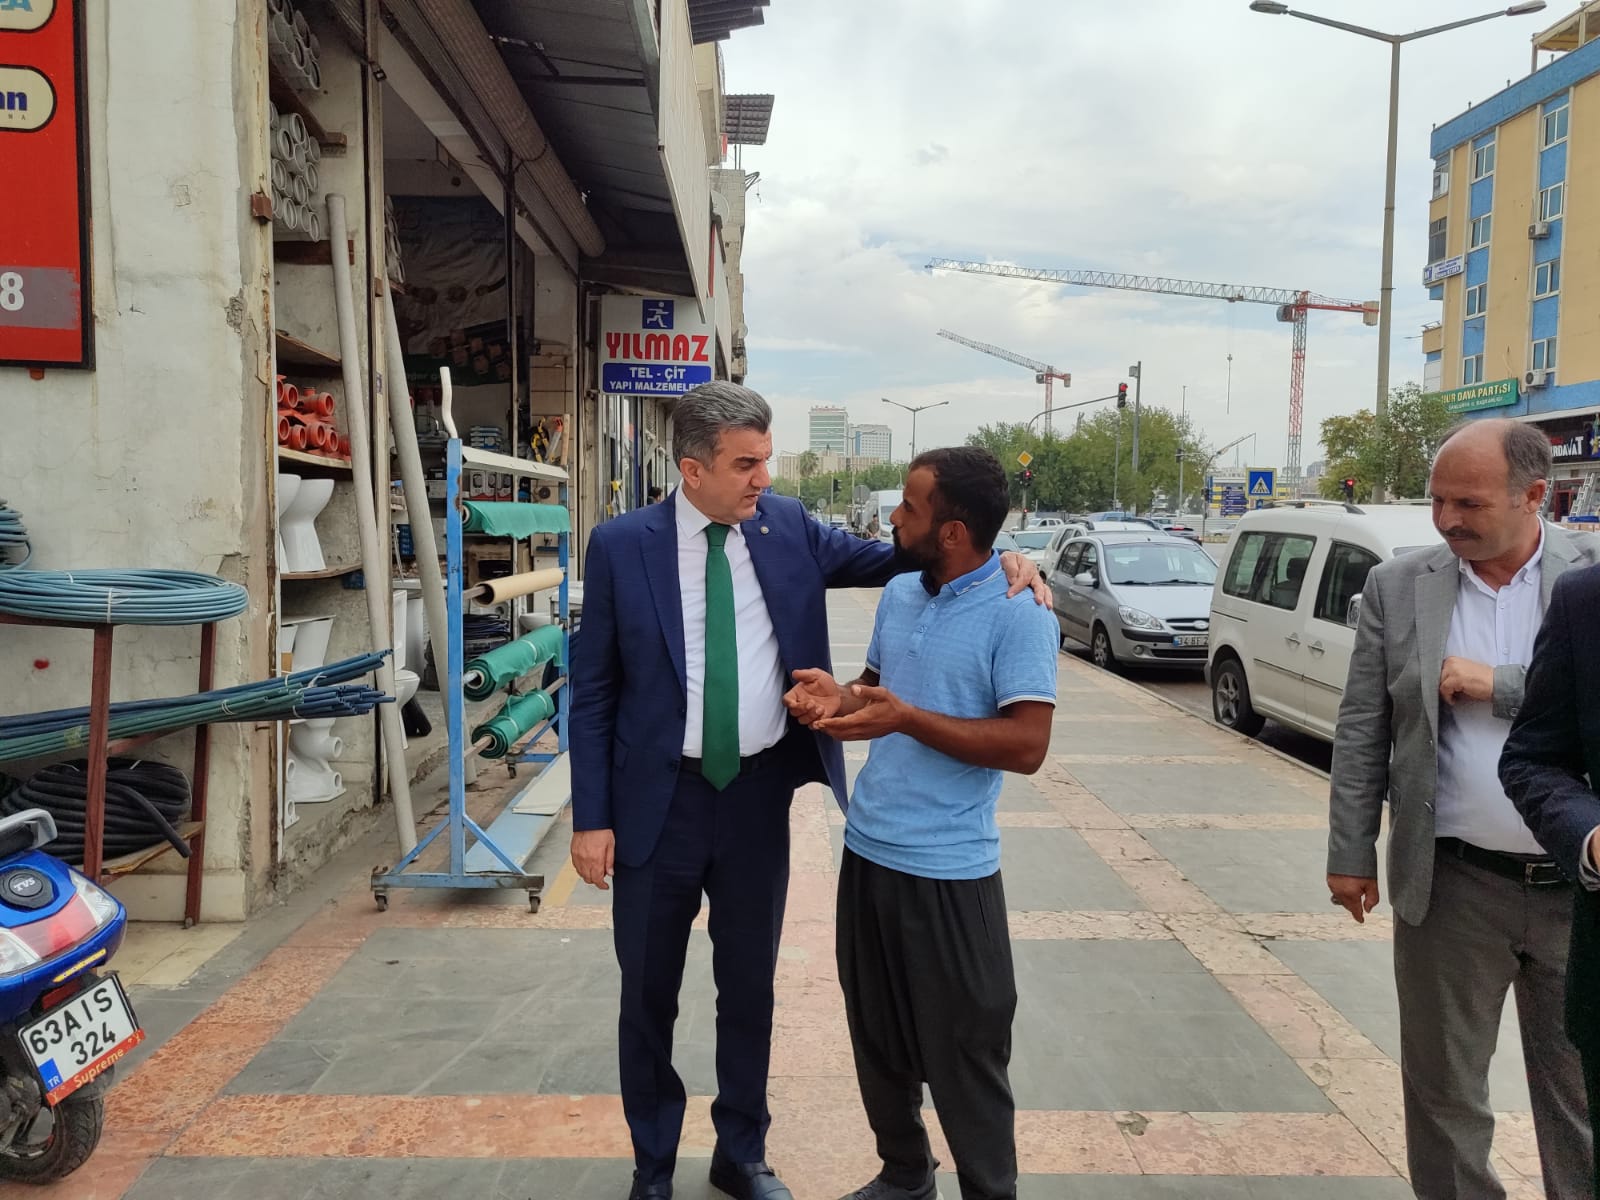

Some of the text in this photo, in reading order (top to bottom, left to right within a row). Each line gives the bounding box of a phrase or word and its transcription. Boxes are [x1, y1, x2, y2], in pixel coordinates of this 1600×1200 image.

[0, 271, 25, 311] 8
[606, 332, 709, 361] YILMAZ
[629, 367, 653, 378] TEL
[664, 366, 686, 381] ÇİT
[609, 381, 705, 392] YAPI MALZEMELE
[1457, 390, 1476, 402] DAVA
[14, 877, 35, 891] TVS
[70, 1022, 116, 1065] 324
[73, 1048, 124, 1088] Supreme
[48, 1075, 60, 1087] TR
